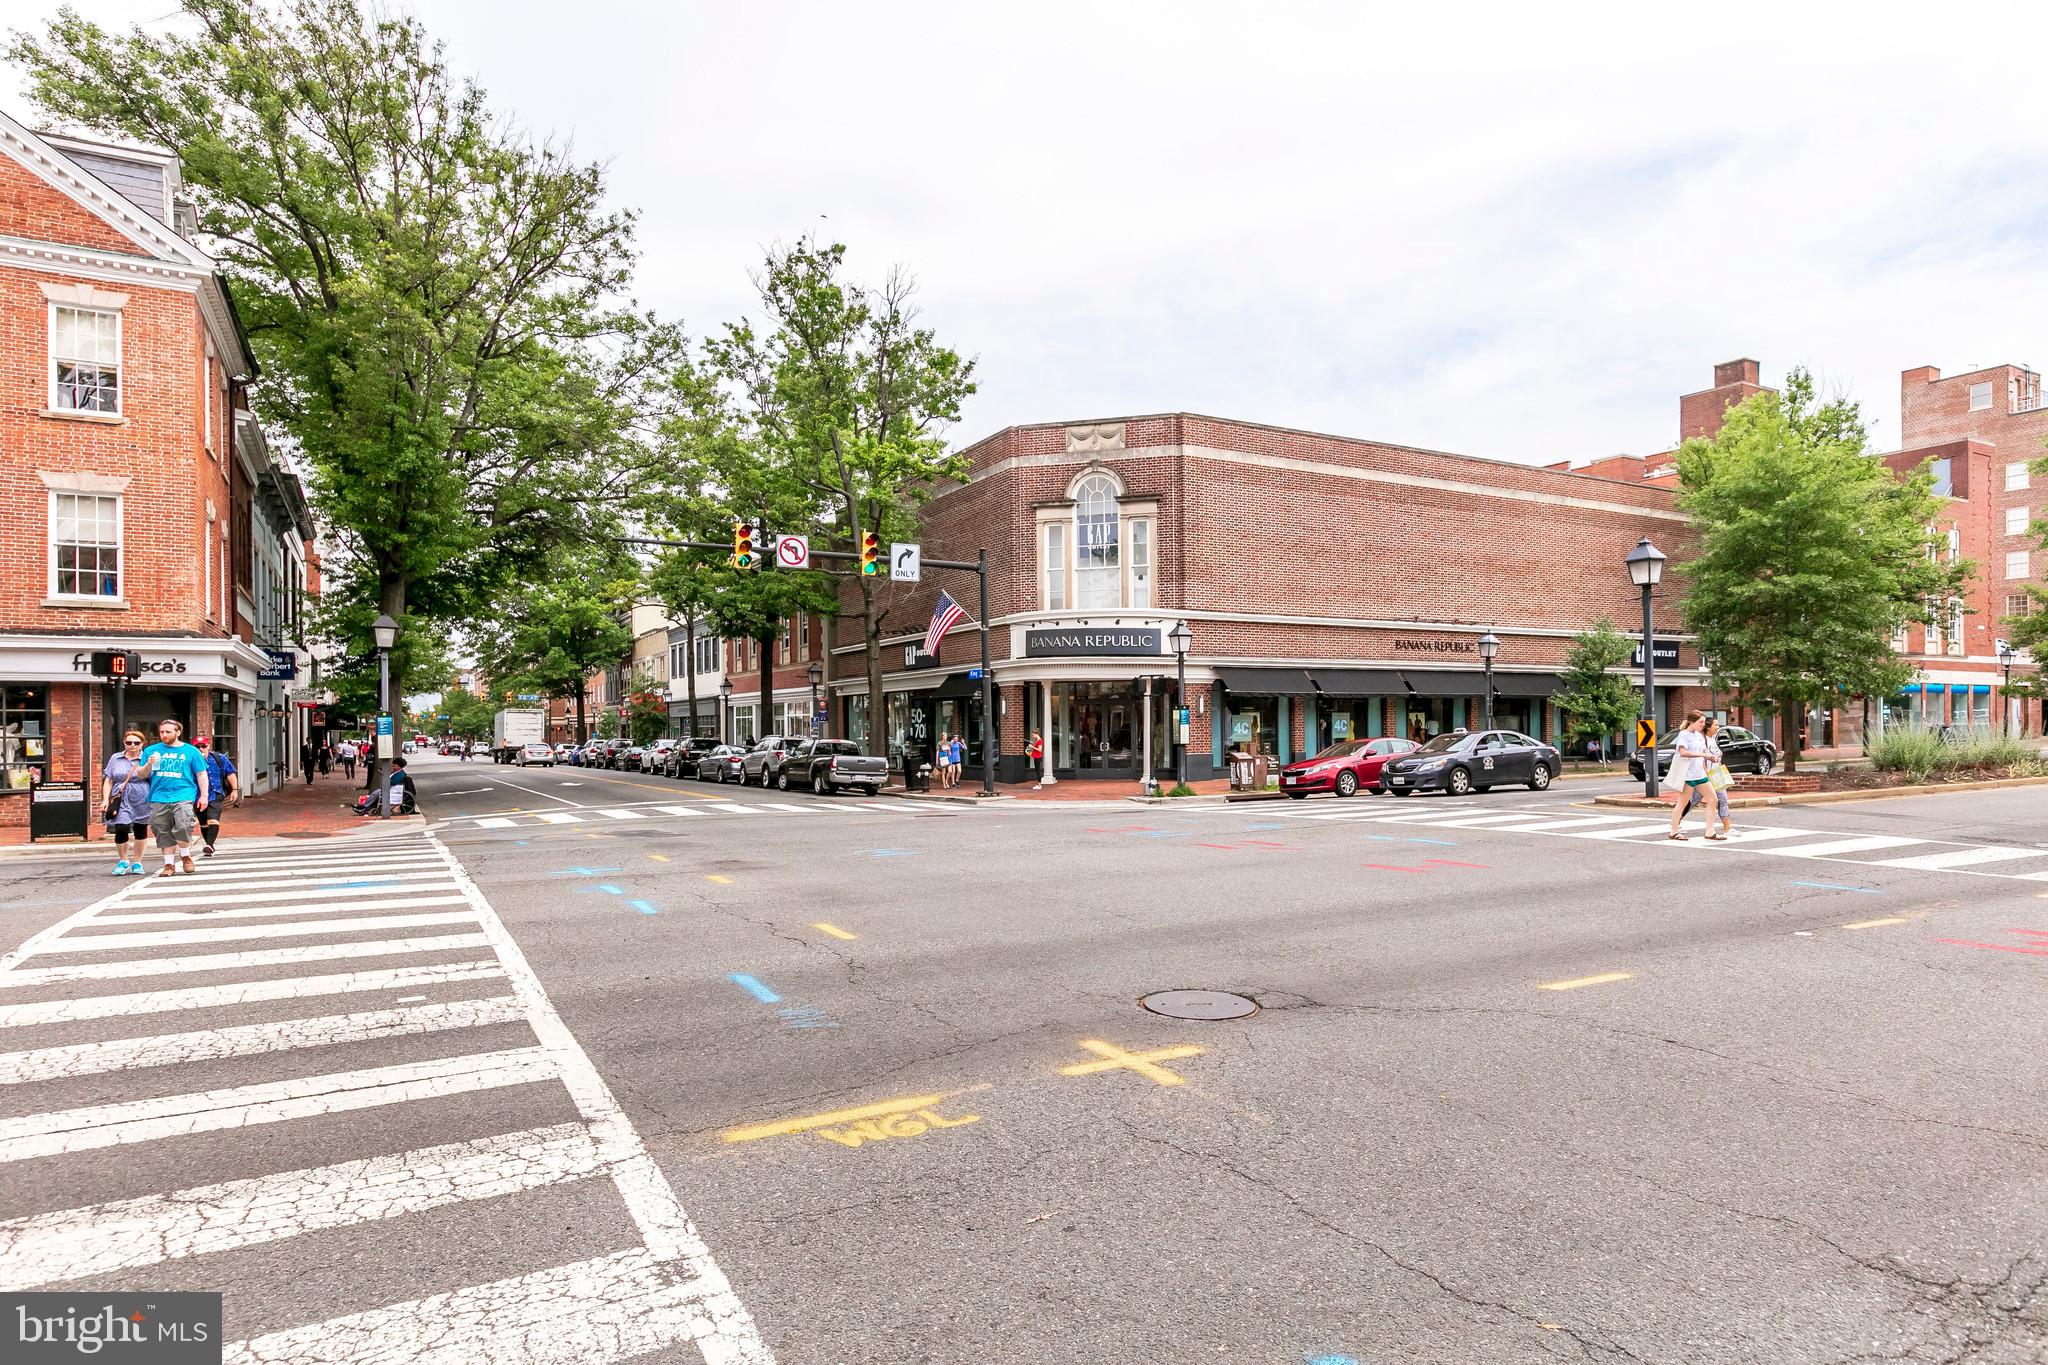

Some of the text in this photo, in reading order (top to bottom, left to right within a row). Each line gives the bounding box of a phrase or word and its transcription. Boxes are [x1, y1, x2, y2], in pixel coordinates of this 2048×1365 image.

[1031, 635, 1153, 648] BANANA REPUBLIC
[1395, 640, 1475, 653] BANANA REPUBLIC
[72, 653, 187, 674] frsca's
[905, 646, 916, 665] GAP
[113, 657, 125, 673] 10
